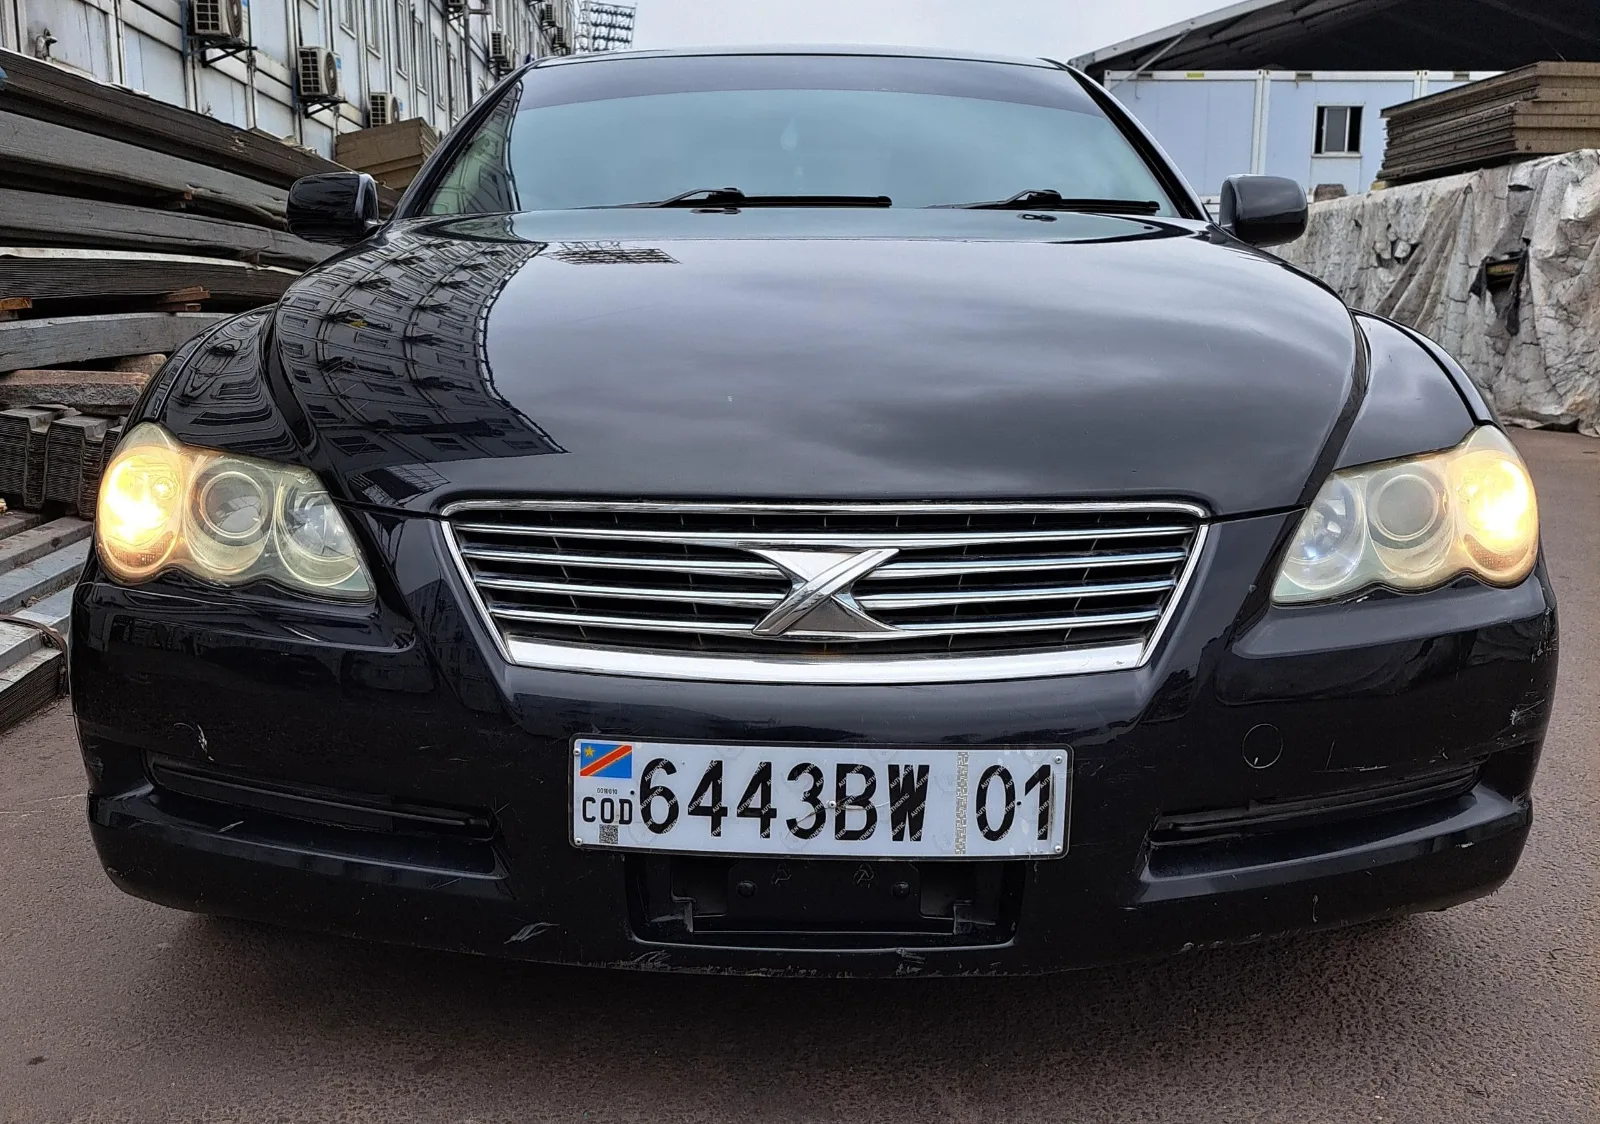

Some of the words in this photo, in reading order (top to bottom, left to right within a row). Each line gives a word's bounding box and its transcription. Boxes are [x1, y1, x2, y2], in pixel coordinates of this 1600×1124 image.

[582, 796, 633, 825] COD
[640, 758, 929, 842] 6443BW
[976, 765, 1050, 842] 01
